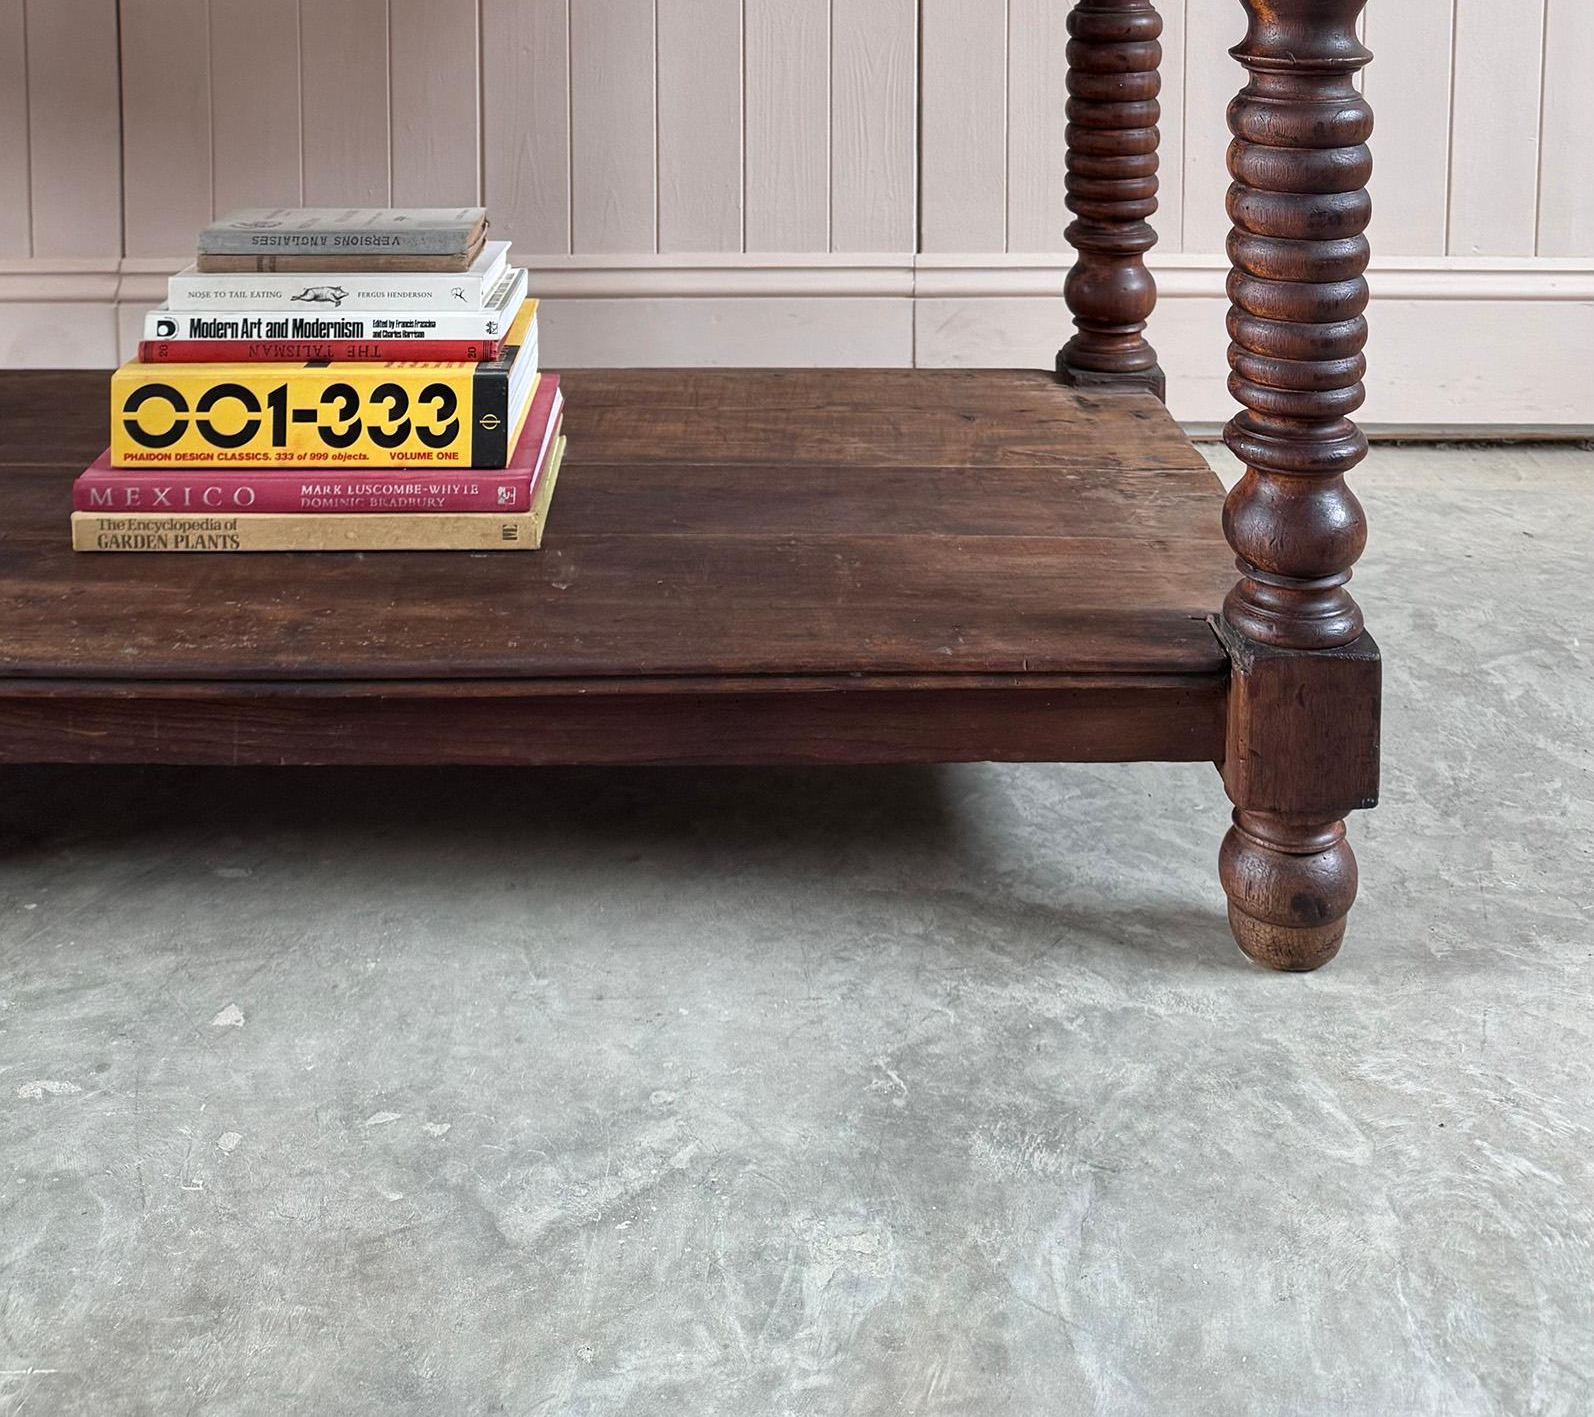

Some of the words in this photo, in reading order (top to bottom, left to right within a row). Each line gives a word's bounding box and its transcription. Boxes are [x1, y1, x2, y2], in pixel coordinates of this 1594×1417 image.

[252, 235, 328, 246] ANGLAISES
[334, 235, 400, 246] VERSIONS
[188, 291, 211, 299] NOSE
[214, 291, 226, 299] TO
[229, 291, 248, 299] TAIL
[250, 291, 283, 299] EATING
[190, 318, 239, 339] Modern
[241, 318, 262, 339] Art
[266, 318, 289, 339] and
[292, 318, 364, 339] Modernism
[372, 319, 388, 329] Edited
[249, 345, 335, 358] TALISMAN
[347, 345, 382, 358] THE
[123, 452, 172, 461] PHAIDON
[175, 452, 214, 461] DESIGN
[217, 452, 272, 461] CLASSICS.
[275, 452, 294, 461] 333
[297, 452, 307, 461] of
[310, 452, 329, 461] 999
[331, 452, 370, 462] objects.
[389, 452, 433, 461] VOLUME
[436, 452, 459, 461] ONE
[301, 484, 342, 496] MARK
[347, 484, 479, 496] LUSCOMBE-WHYTE
[89, 486, 256, 507] MEXICO
[301, 497, 366, 508] DOMINIC
[370, 497, 446, 508] BRADBURY
[97, 518, 125, 531] The
[128, 518, 222, 534] Encyclopedia
[224, 518, 238, 531] of
[97, 534, 168, 550] GARDEN
[173, 534, 241, 550] PLANTS
